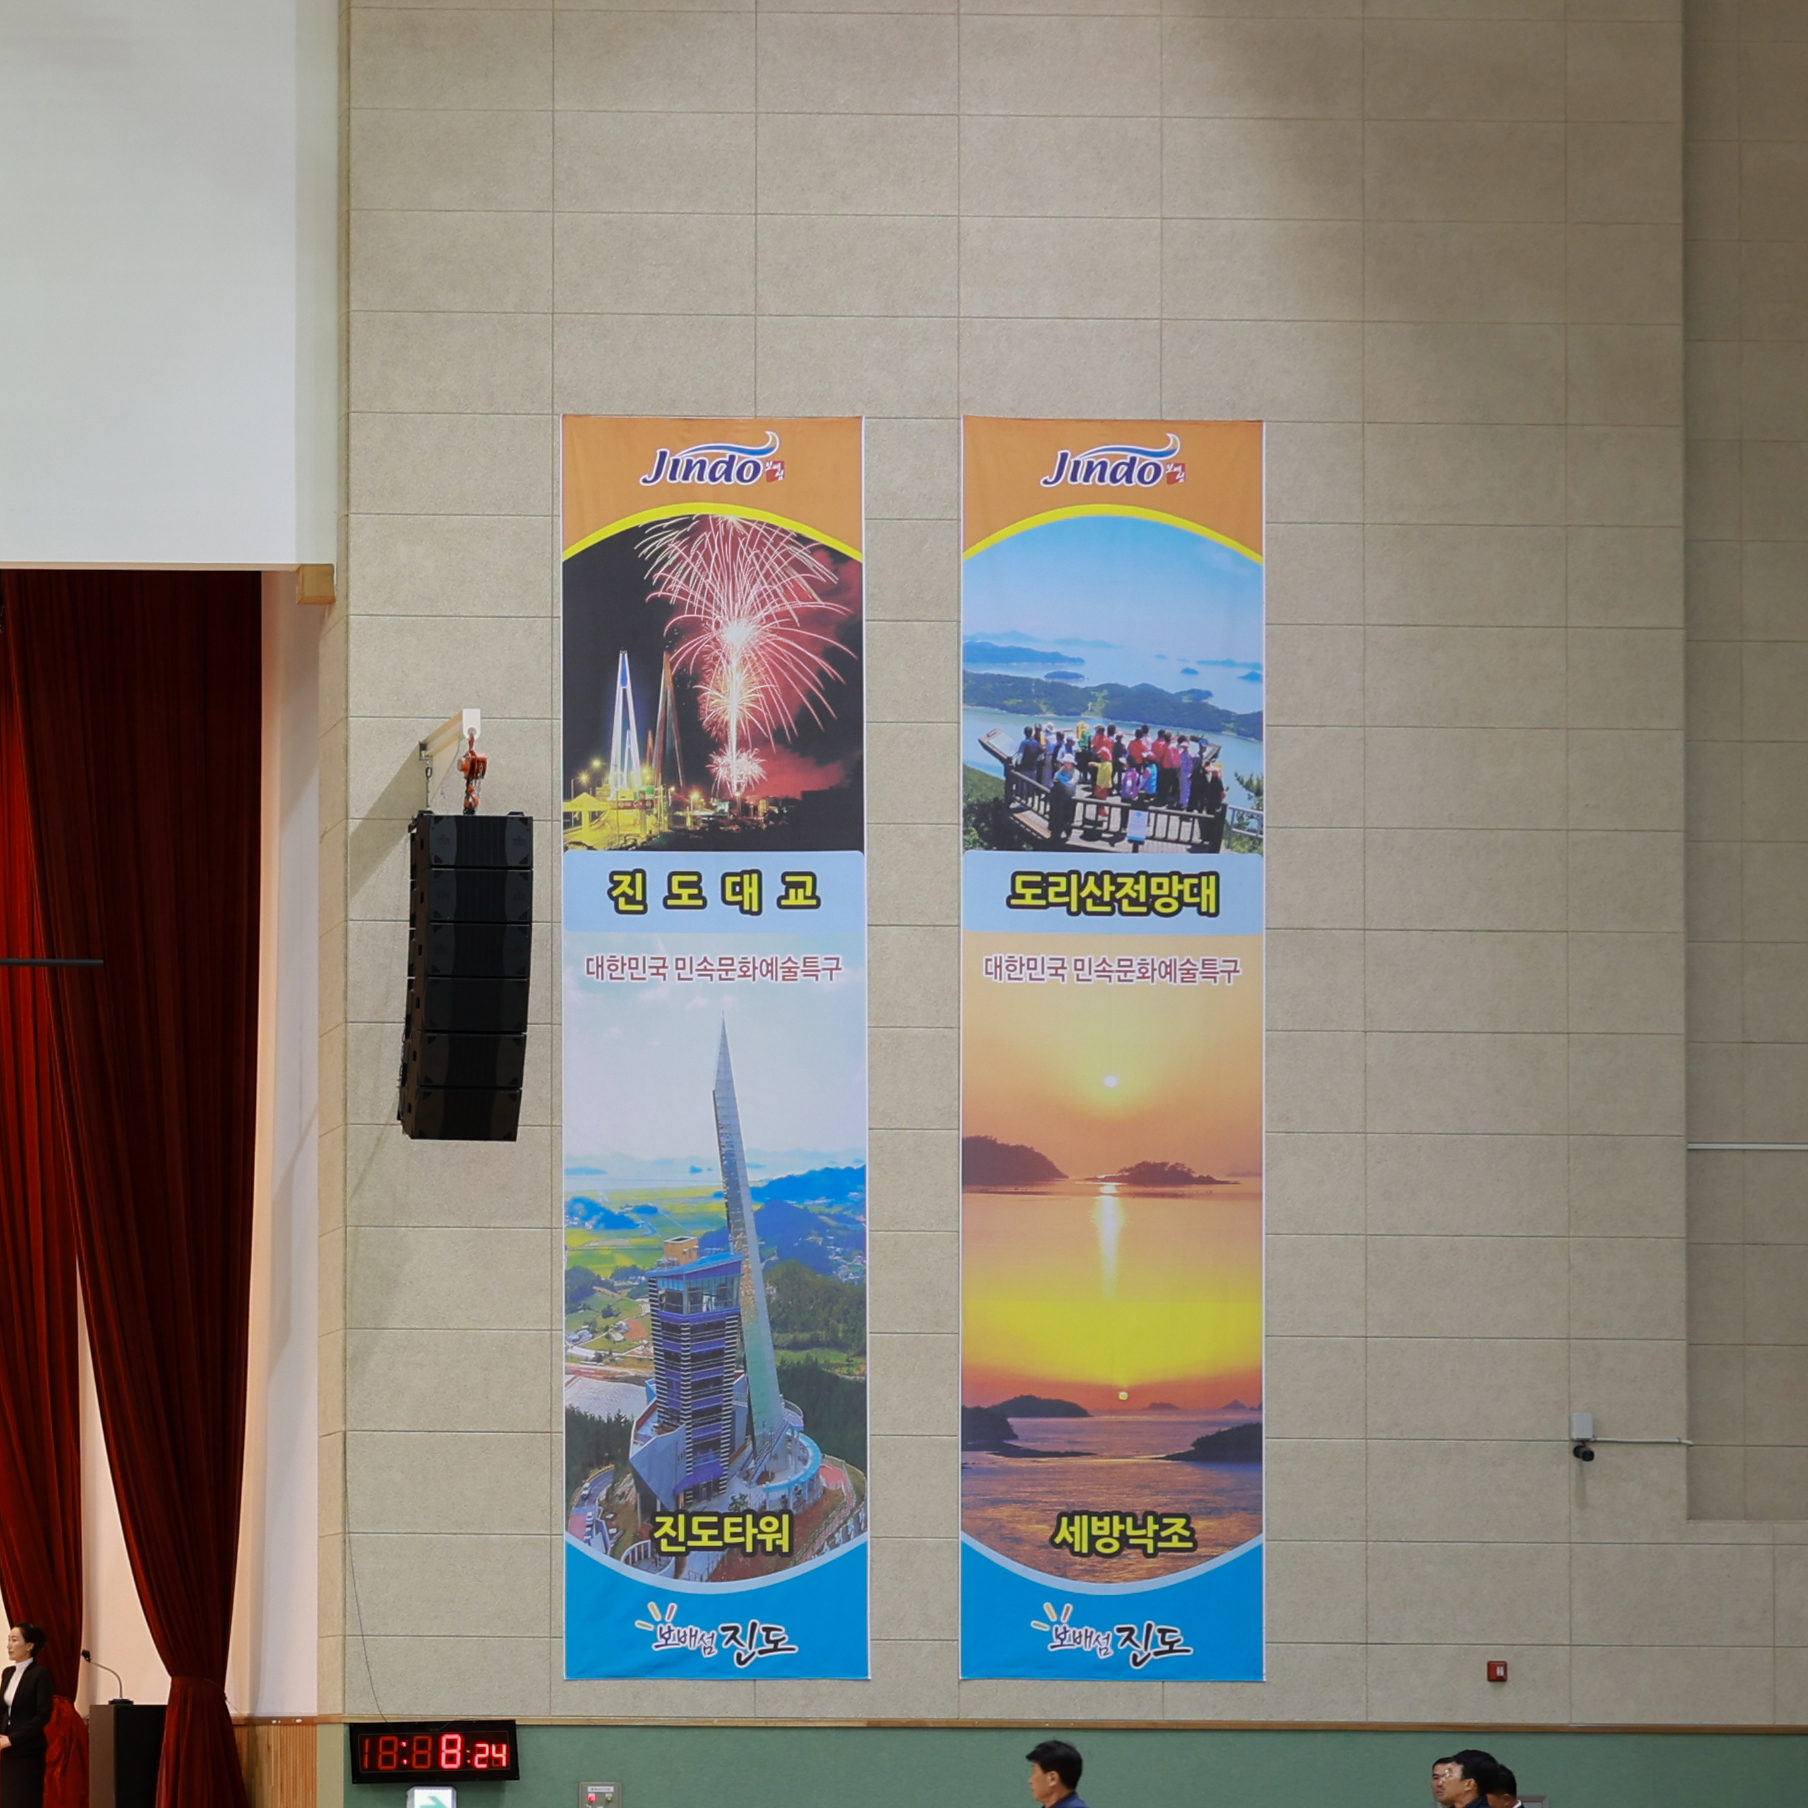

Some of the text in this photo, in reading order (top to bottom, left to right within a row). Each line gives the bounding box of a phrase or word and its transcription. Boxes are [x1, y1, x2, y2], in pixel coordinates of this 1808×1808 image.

[639, 448, 763, 486] Jindo
[1040, 450, 1164, 487] Jindo
[1009, 873, 1217, 914] 도리산전망대
[585, 954, 843, 982] 대한민국 민속문화예술특구
[984, 954, 1241, 984] 대한민국 민속문화예술특구
[653, 1513, 790, 1553] 진도타워
[1053, 1514, 1194, 1554] 세방낙조
[653, 1619, 799, 1668] 보배섬 진도
[1048, 1620, 1194, 1669] 보배섬 진도
